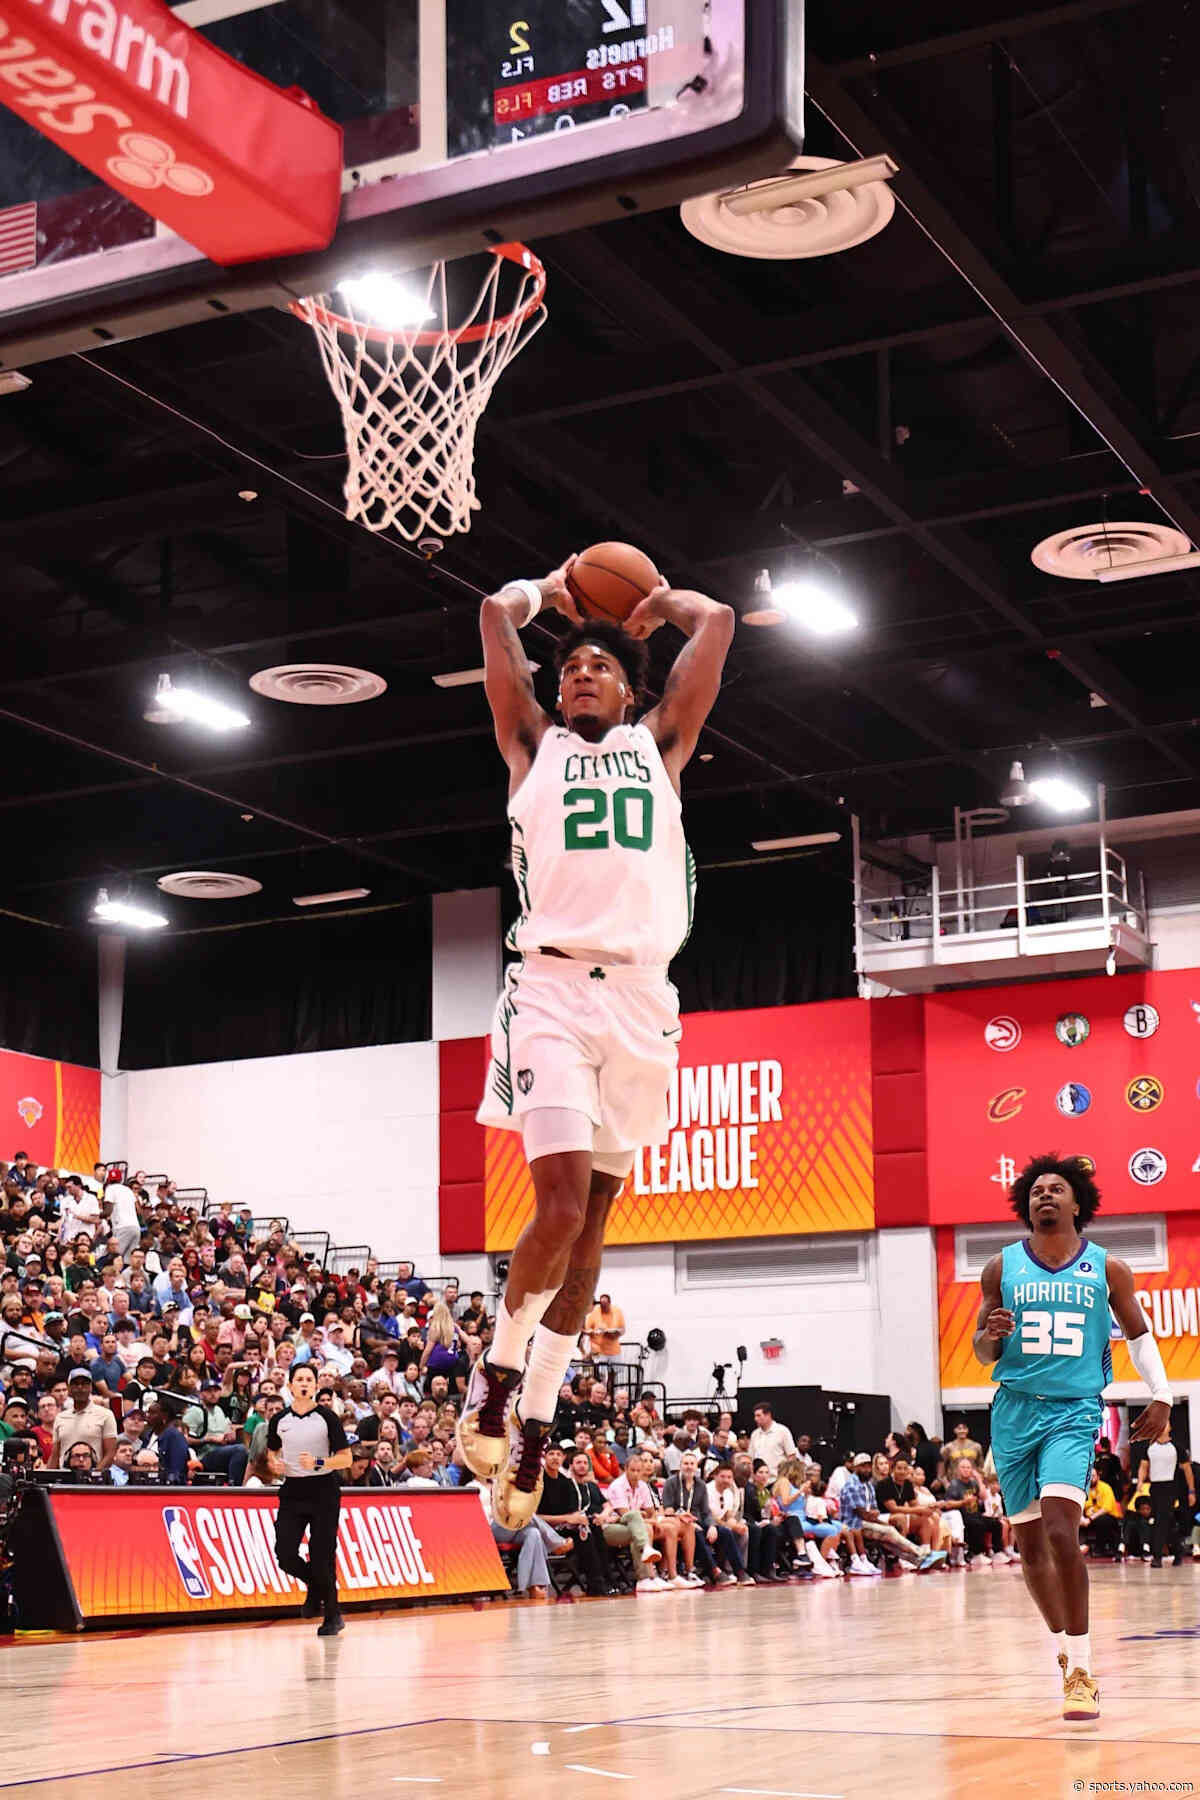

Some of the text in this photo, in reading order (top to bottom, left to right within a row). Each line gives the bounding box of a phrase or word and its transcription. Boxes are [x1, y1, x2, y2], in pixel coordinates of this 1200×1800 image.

[563, 787, 654, 852] 20
[666, 1060, 783, 1130] UMMER
[633, 1125, 760, 1196] LEAGUE
[1013, 1281, 1095, 1309] HORNETS
[1134, 1287, 1200, 1338] SUM
[1021, 1311, 1085, 1357] 35
[335, 1506, 435, 1590] LEAGUE
